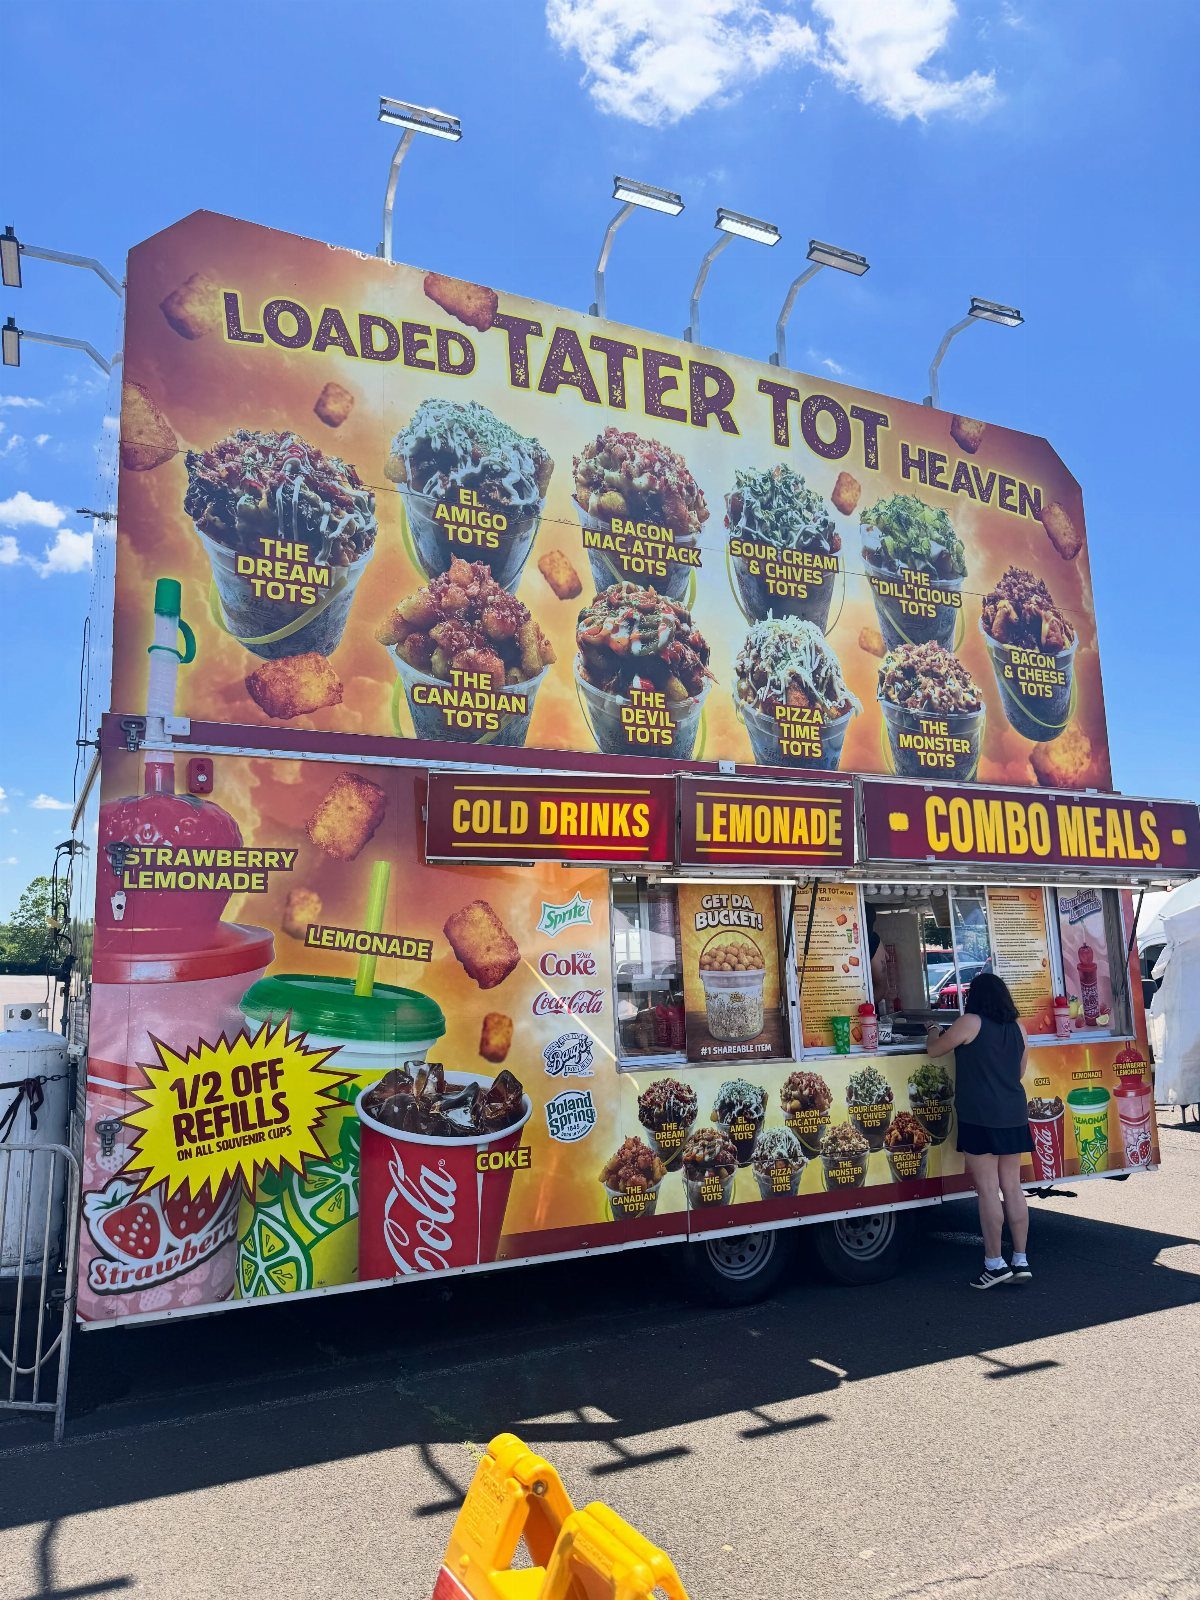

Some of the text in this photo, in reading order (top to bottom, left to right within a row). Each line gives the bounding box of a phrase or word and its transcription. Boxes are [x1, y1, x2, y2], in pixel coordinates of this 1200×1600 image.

[223, 292, 1044, 521] LOADED TATER TOT HEAVEN
[460, 488, 484, 508] EL
[435, 503, 508, 531] AMIGO
[444, 523, 500, 549] TOTS
[611, 517, 674, 543] BACON
[259, 537, 309, 563] THE
[584, 530, 700, 565] MAC ATTACK
[730, 540, 838, 571] SOUR CREAM
[237, 555, 329, 587] DREAM
[619, 554, 668, 577] TOTS
[749, 560, 823, 586] & CHIVES
[901, 569, 930, 587] THE
[250, 578, 316, 605] TOTS
[765, 579, 808, 599] TOTS
[899, 599, 937, 618] TOTS
[1011, 650, 1056, 670] BACON
[449, 669, 492, 691] THE
[1004, 665, 1066, 686] & CHEESE
[629, 689, 666, 709] THE
[1019, 681, 1053, 698] TOTS
[413, 686, 526, 714] CANADIAN
[442, 708, 499, 730] TOTS
[621, 707, 676, 728] DEVIL
[775, 705, 824, 725] PIZZA
[624, 725, 673, 745] TOTS
[780, 722, 821, 741] TIME
[919, 719, 949, 736] THE
[779, 740, 822, 758] TOTS
[899, 733, 971, 754] MONSTER
[917, 751, 956, 768] TOTS
[452, 798, 650, 838] COLD DRINKS
[695, 802, 843, 846] LEMONADE
[925, 795, 1161, 861] COMBO MEALS
[124, 847, 296, 869] STRAWBERRY
[123, 870, 265, 890] LEMONADE
[701, 893, 753, 911] GET DA
[544, 902, 586, 931] Sprite
[695, 909, 764, 931] BUCKET!
[307, 927, 431, 959] LEMONADE
[540, 952, 597, 976] Coke
[576, 951, 592, 959] Diet
[532, 989, 606, 1016] Coca-Cola
[700, 1043, 772, 1056] #1 SHAREABLE ITEM
[1072, 1070, 1102, 1080] LEMONADE
[1112, 1061, 1147, 1071] STRAWBERRY
[1116, 1068, 1145, 1076] LEMONADE
[169, 1071, 224, 1110] 1/2
[231, 1057, 285, 1098] OFF
[1034, 1078, 1050, 1086] COKE
[546, 1091, 594, 1119] Poland
[848, 1104, 893, 1115] SOUR CREAM
[925, 1099, 939, 1107] THE
[172, 1091, 290, 1148] REFILLS
[549, 1108, 596, 1137] Spring
[737, 1116, 747, 1124] EL
[785, 1117, 830, 1128] MAC ATTACK
[795, 1109, 820, 1119] BACON
[856, 1112, 887, 1121] & CHIVES
[863, 1119, 881, 1128] TOTS
[925, 1113, 942, 1122] TOTS
[655, 1129, 685, 1141] DREAM
[661, 1122, 678, 1131] THE
[729, 1123, 756, 1133] AMIGO
[733, 1131, 753, 1140] TOTS
[799, 1125, 818, 1134] TOTS
[177, 1125, 292, 1162] ON ALL SOUVENIR CUPS
[660, 1138, 682, 1148] TOTS
[476, 1149, 529, 1171] COKE
[838, 1160, 853, 1169] THE
[893, 1153, 915, 1163] BACON
[896, 1158, 921, 1169] CHEESE
[704, 1175, 720, 1185] THE
[770, 1167, 792, 1177] PIZZA
[772, 1176, 790, 1185] TIME
[828, 1166, 863, 1178] MONSTER
[836, 1175, 855, 1184] TOTS
[899, 1166, 917, 1176] TOTS
[626, 1185, 642, 1195] THE
[701, 1183, 724, 1194] DEVIL
[702, 1192, 723, 1202] TOTS
[771, 1184, 791, 1193] TOTS
[612, 1192, 656, 1206] CANADIAN
[623, 1203, 645, 1213] TOTS
[94, 1204, 238, 1286] Strawberry
